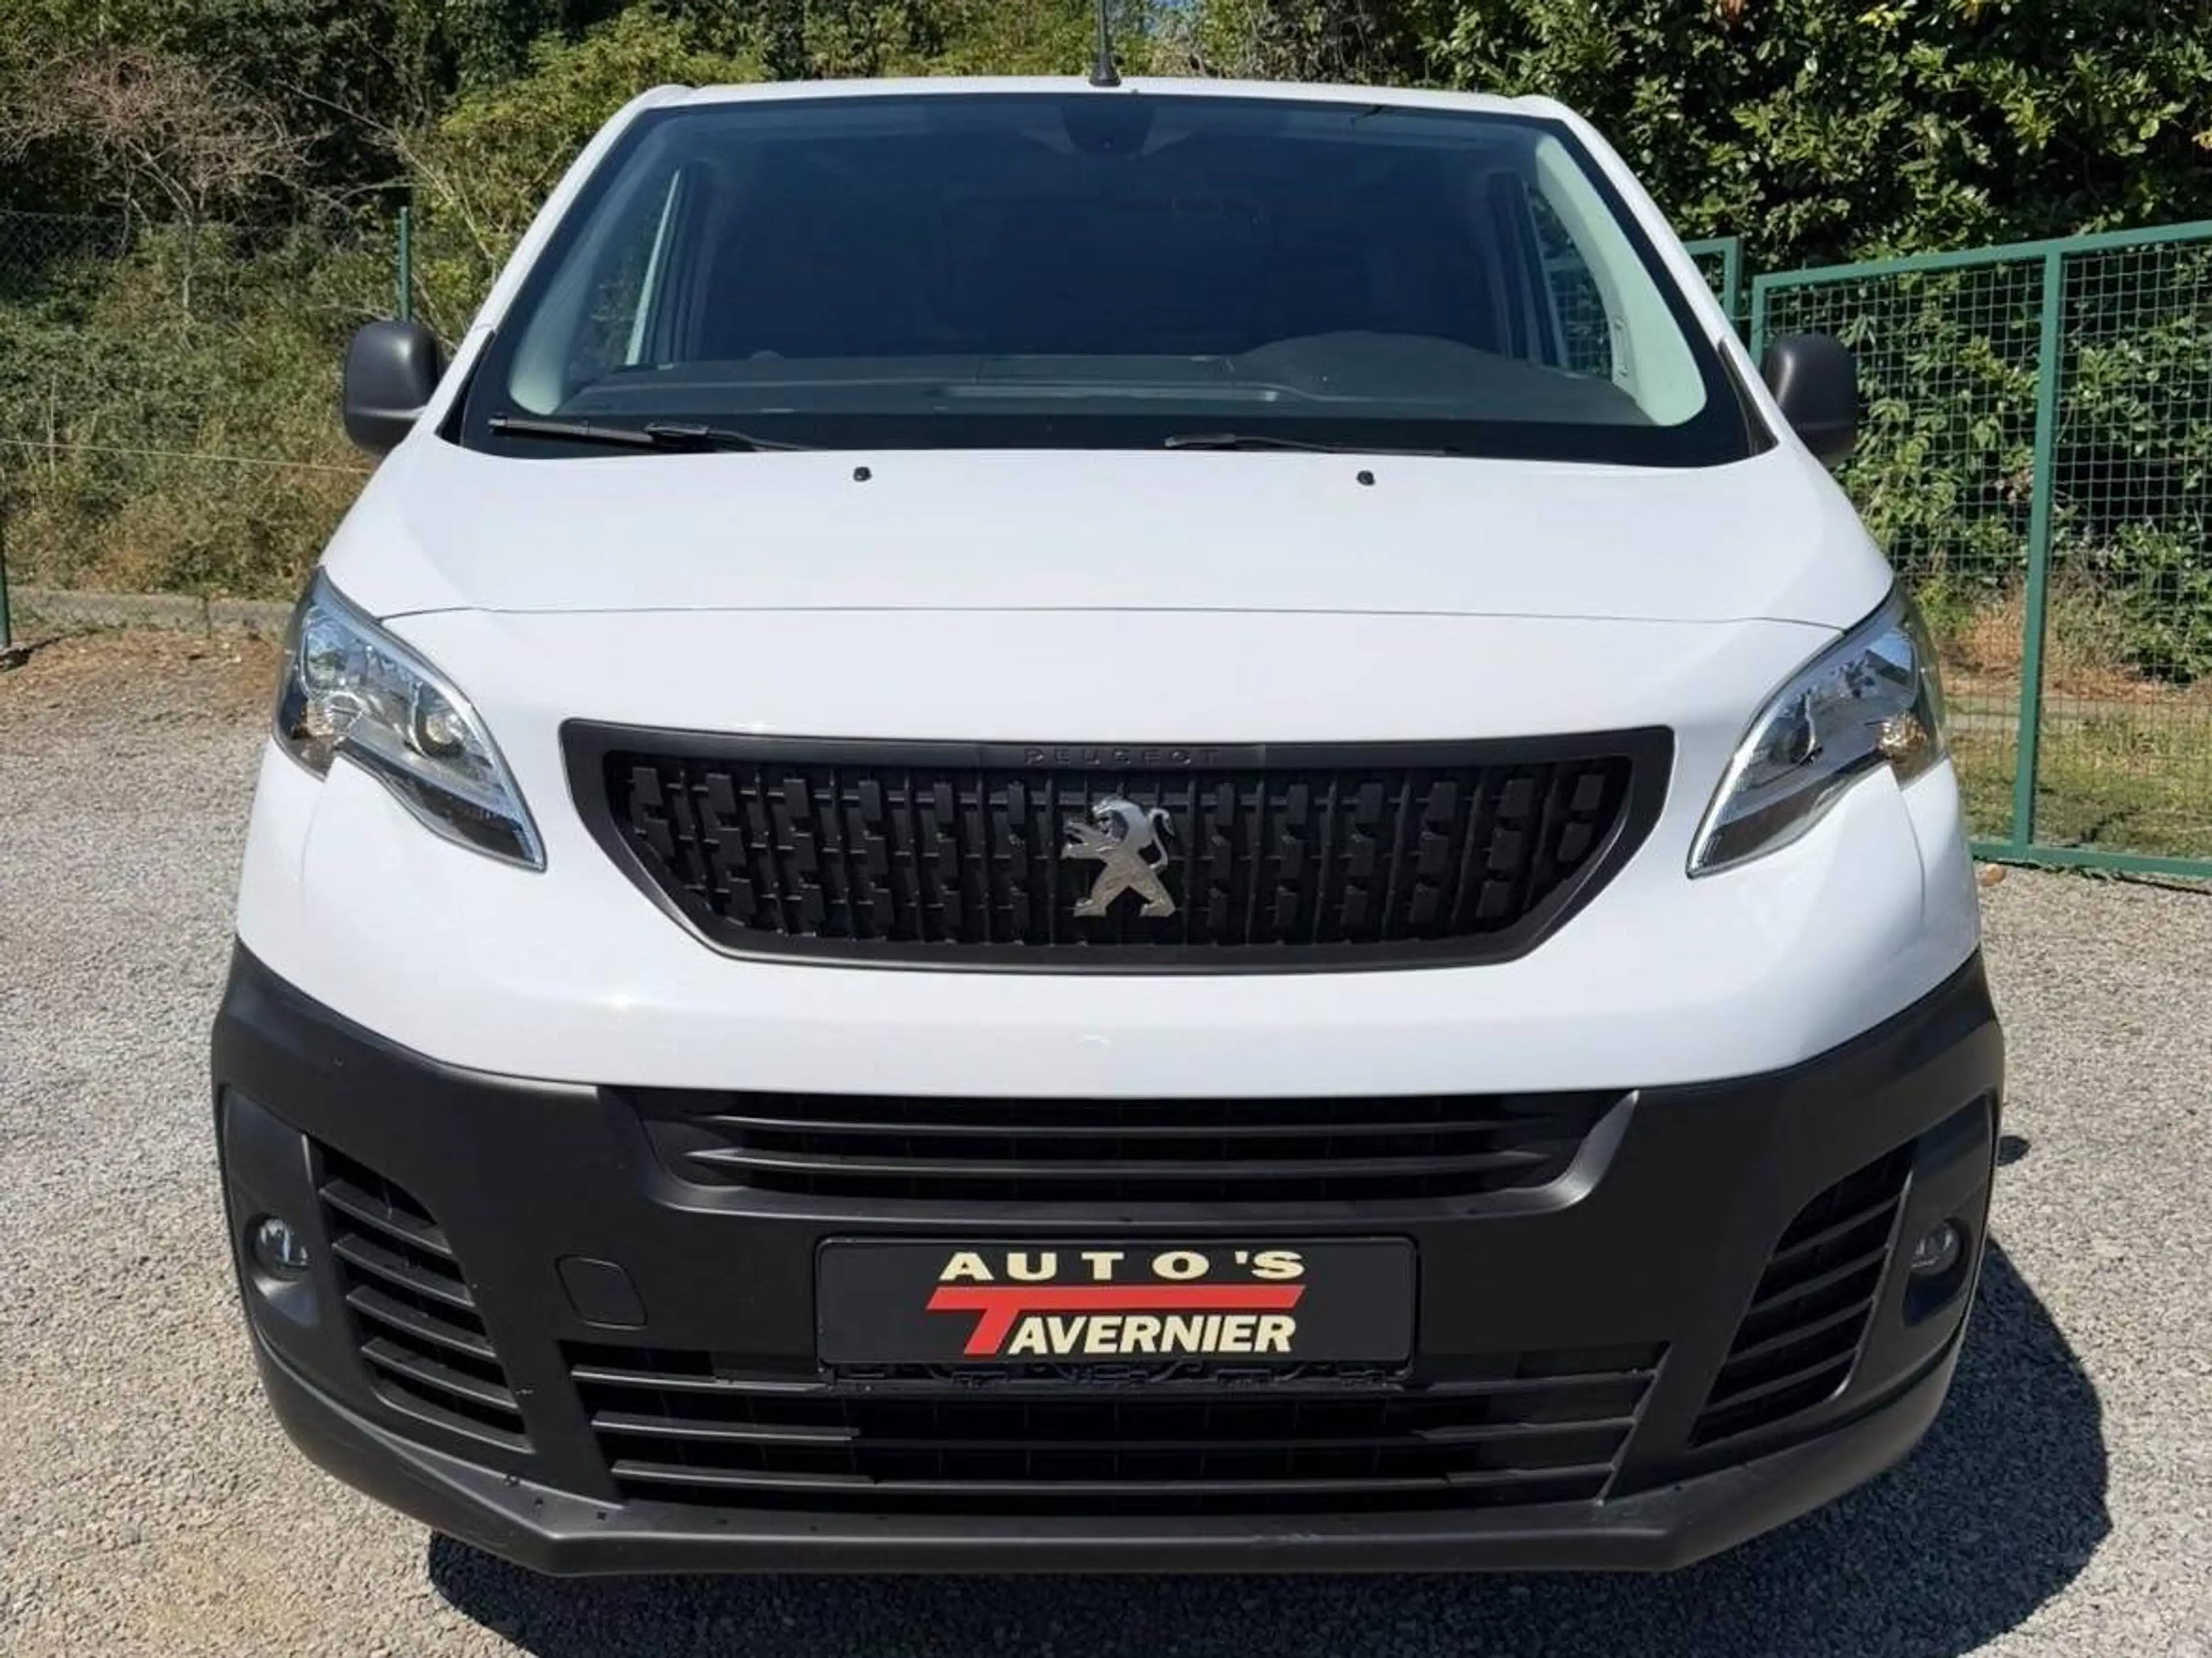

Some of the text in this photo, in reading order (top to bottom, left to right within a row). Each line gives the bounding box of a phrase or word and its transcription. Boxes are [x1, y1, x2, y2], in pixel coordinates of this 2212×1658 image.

[1024, 748, 1221, 767] PEUGEOT
[940, 1251, 1305, 1280] AUTO'S
[926, 1284, 1306, 1355] TAVERNIER
